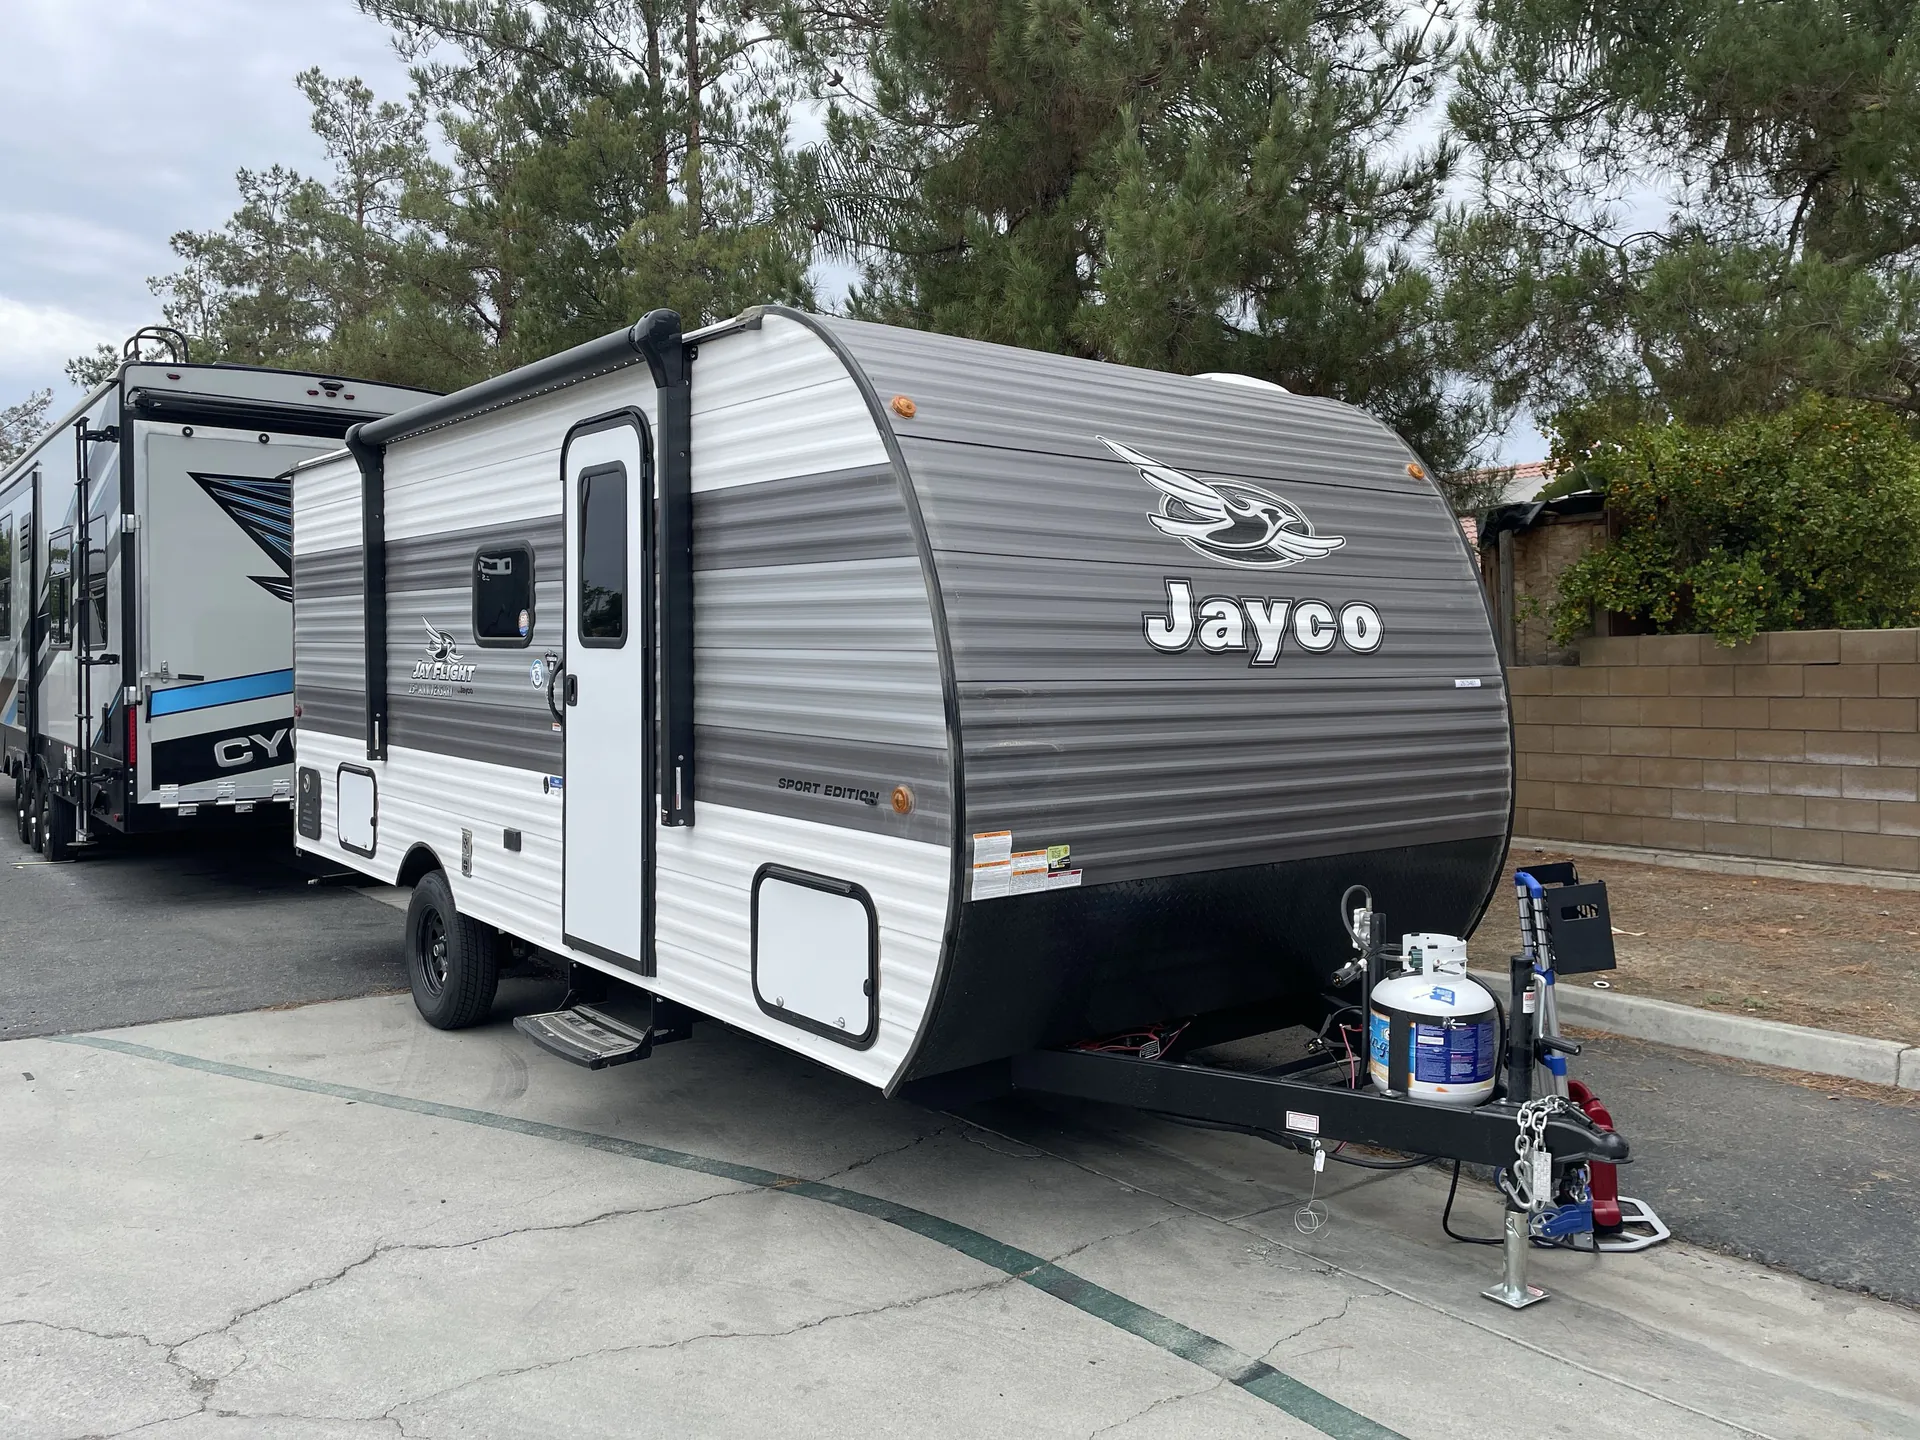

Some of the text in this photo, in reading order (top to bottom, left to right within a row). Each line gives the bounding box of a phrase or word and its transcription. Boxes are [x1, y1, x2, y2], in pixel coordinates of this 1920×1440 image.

[1142, 577, 1384, 667] Jayco
[411, 659, 477, 682] JAY FLIGHT
[214, 728, 295, 768] CY
[778, 778, 880, 802] SPORT EDITION
